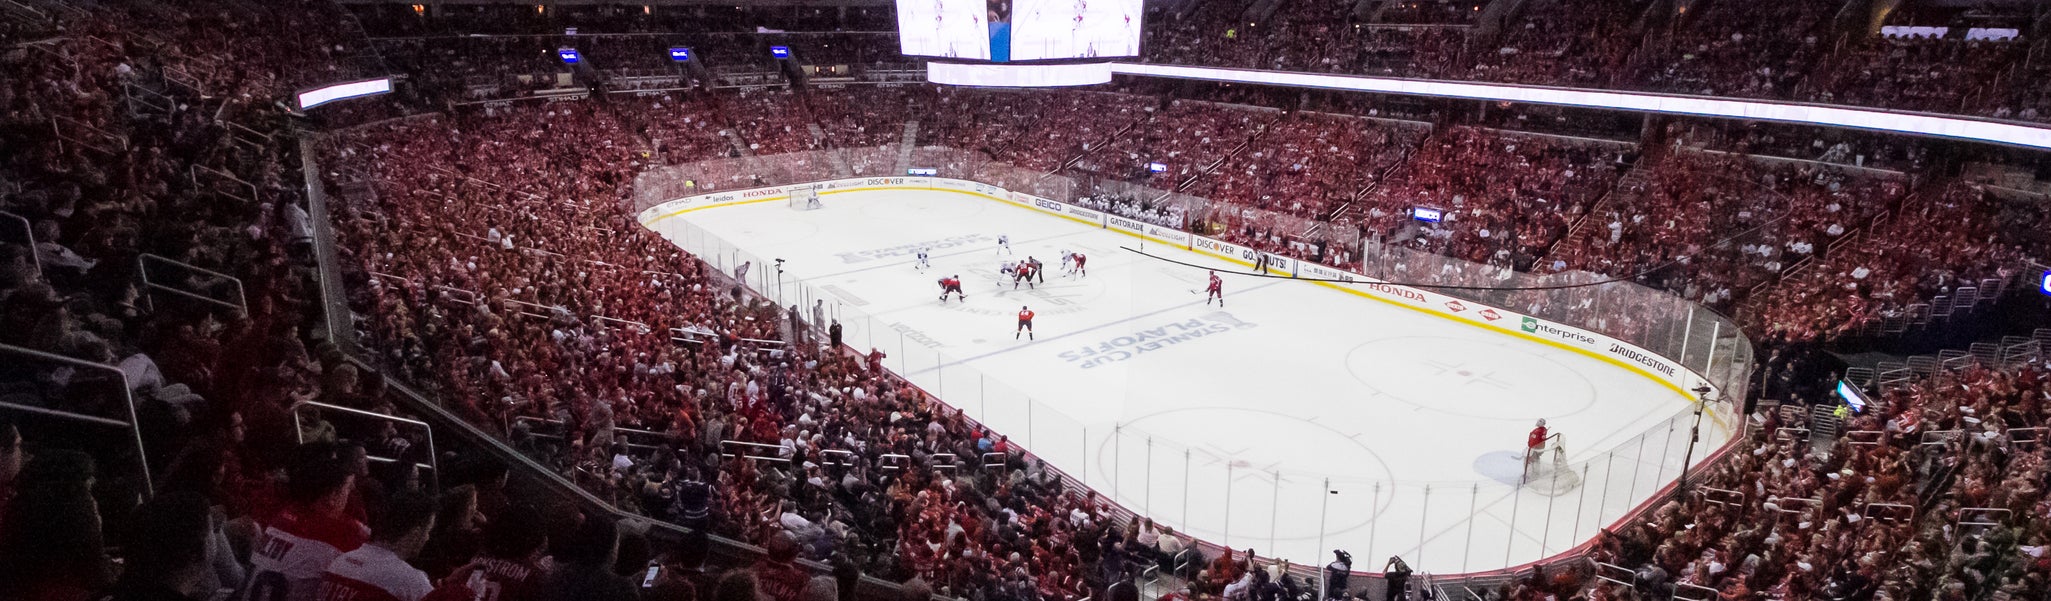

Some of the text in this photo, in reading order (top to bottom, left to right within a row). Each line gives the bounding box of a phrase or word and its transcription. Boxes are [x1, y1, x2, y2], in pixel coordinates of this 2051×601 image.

[867, 178, 904, 186] DISCOVER
[713, 195, 734, 203] leidos
[743, 188, 782, 198] HONDA
[1035, 198, 1062, 212] GEICO
[1110, 217, 1143, 232] GATORADE
[1196, 237, 1235, 255] DISCOVER
[1369, 282, 1428, 303] HONDA
[1522, 316, 1595, 344] enterprise
[1609, 342, 1676, 378] BRIDGESTONE
